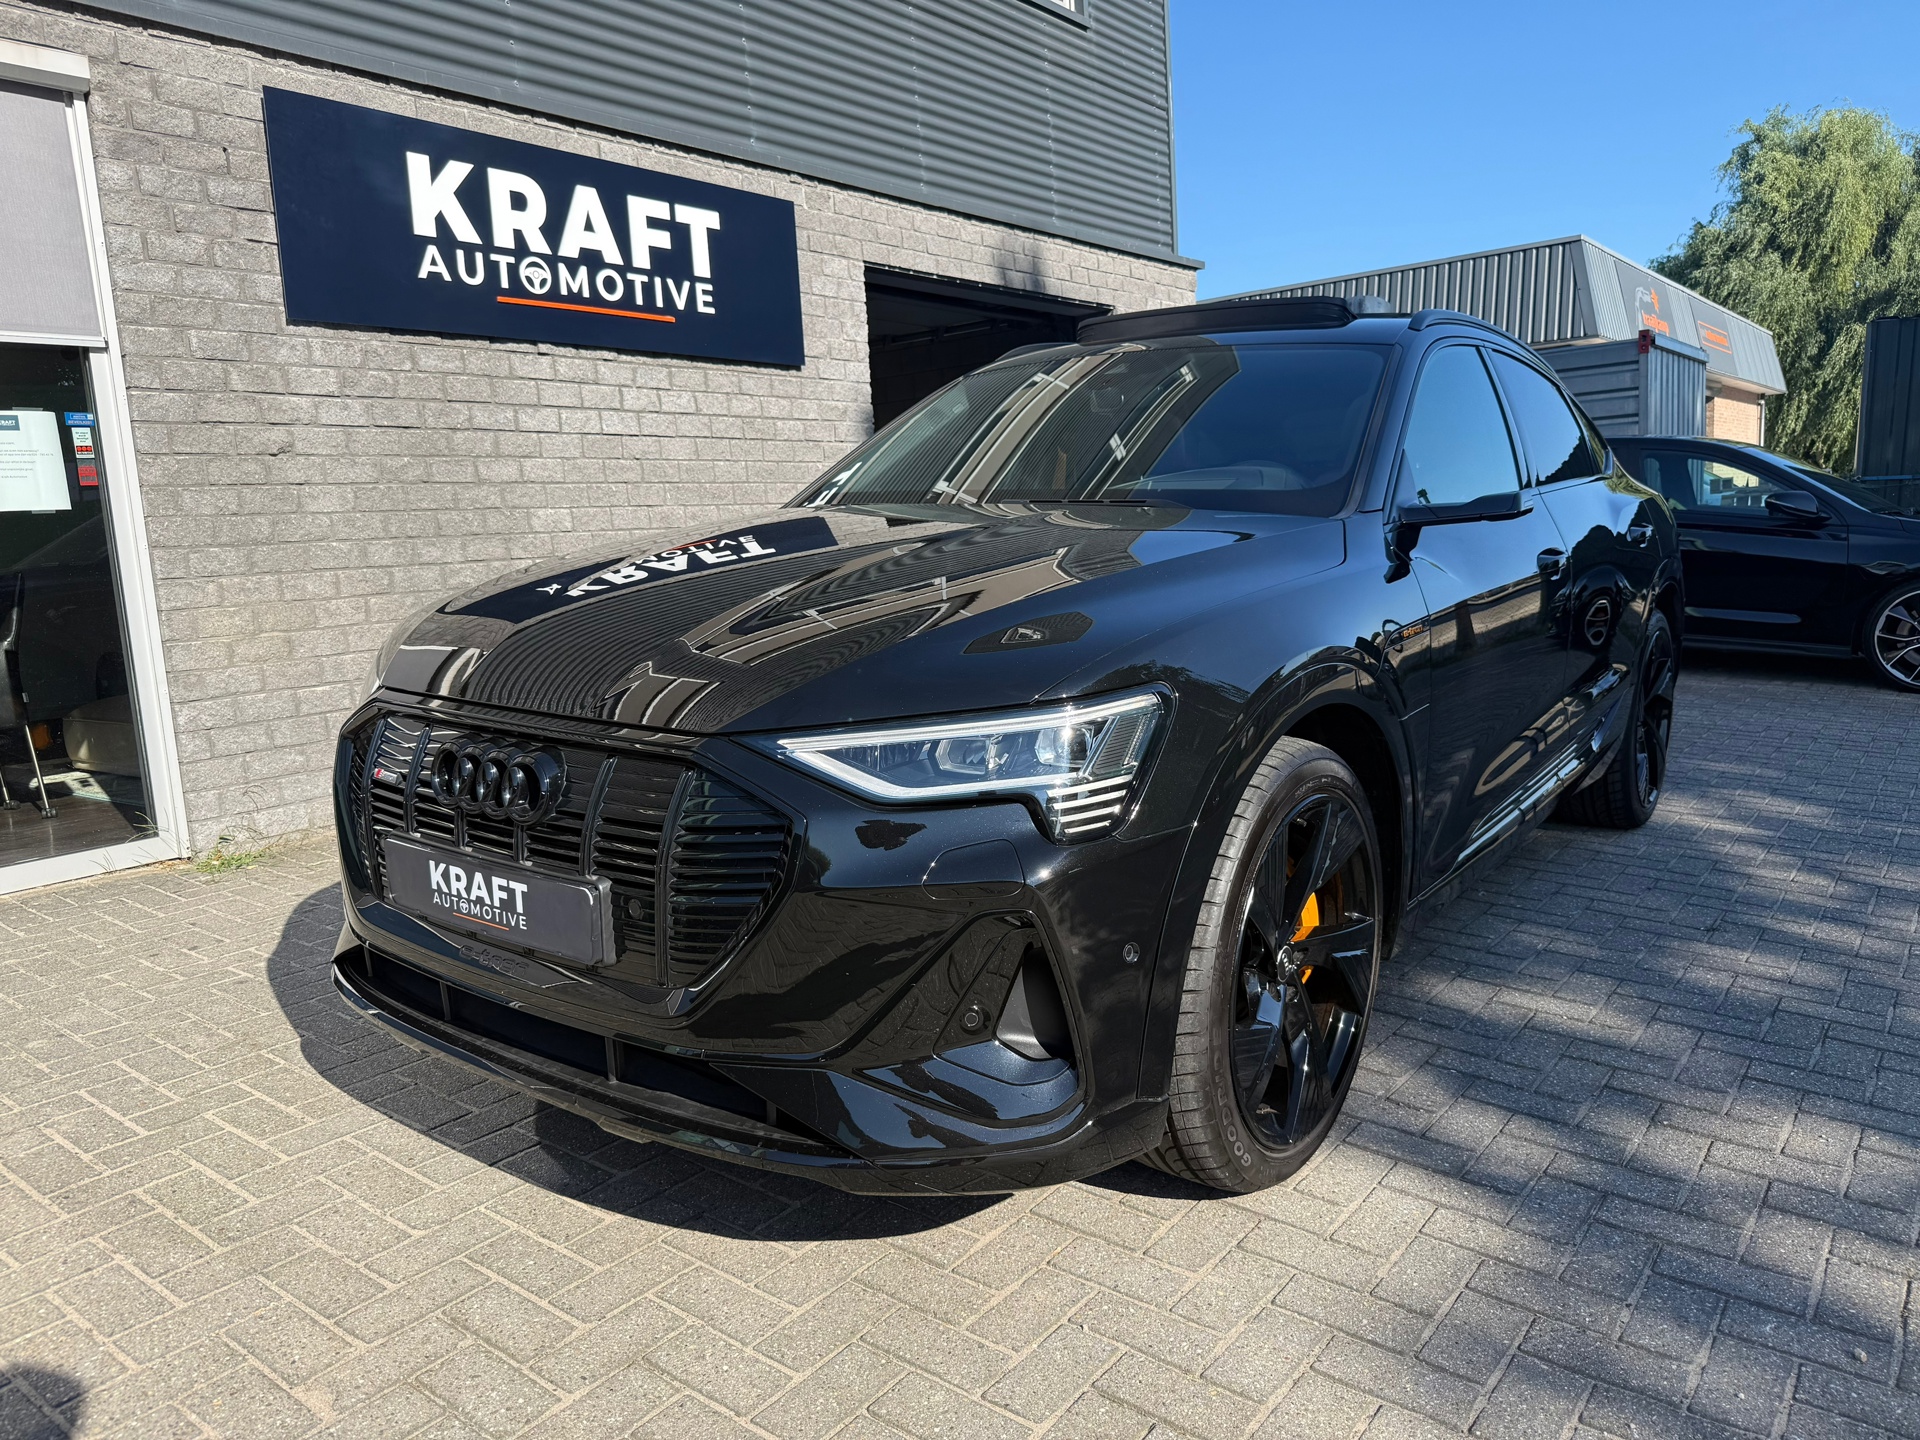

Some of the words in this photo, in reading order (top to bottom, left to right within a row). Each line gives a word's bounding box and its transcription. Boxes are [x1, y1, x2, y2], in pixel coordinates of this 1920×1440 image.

[406, 151, 722, 279] KRAFT
[417, 245, 716, 315] AUTOMOTIVE
[428, 859, 528, 914] KRAFT
[433, 893, 528, 930] AUTOMOTIVE
